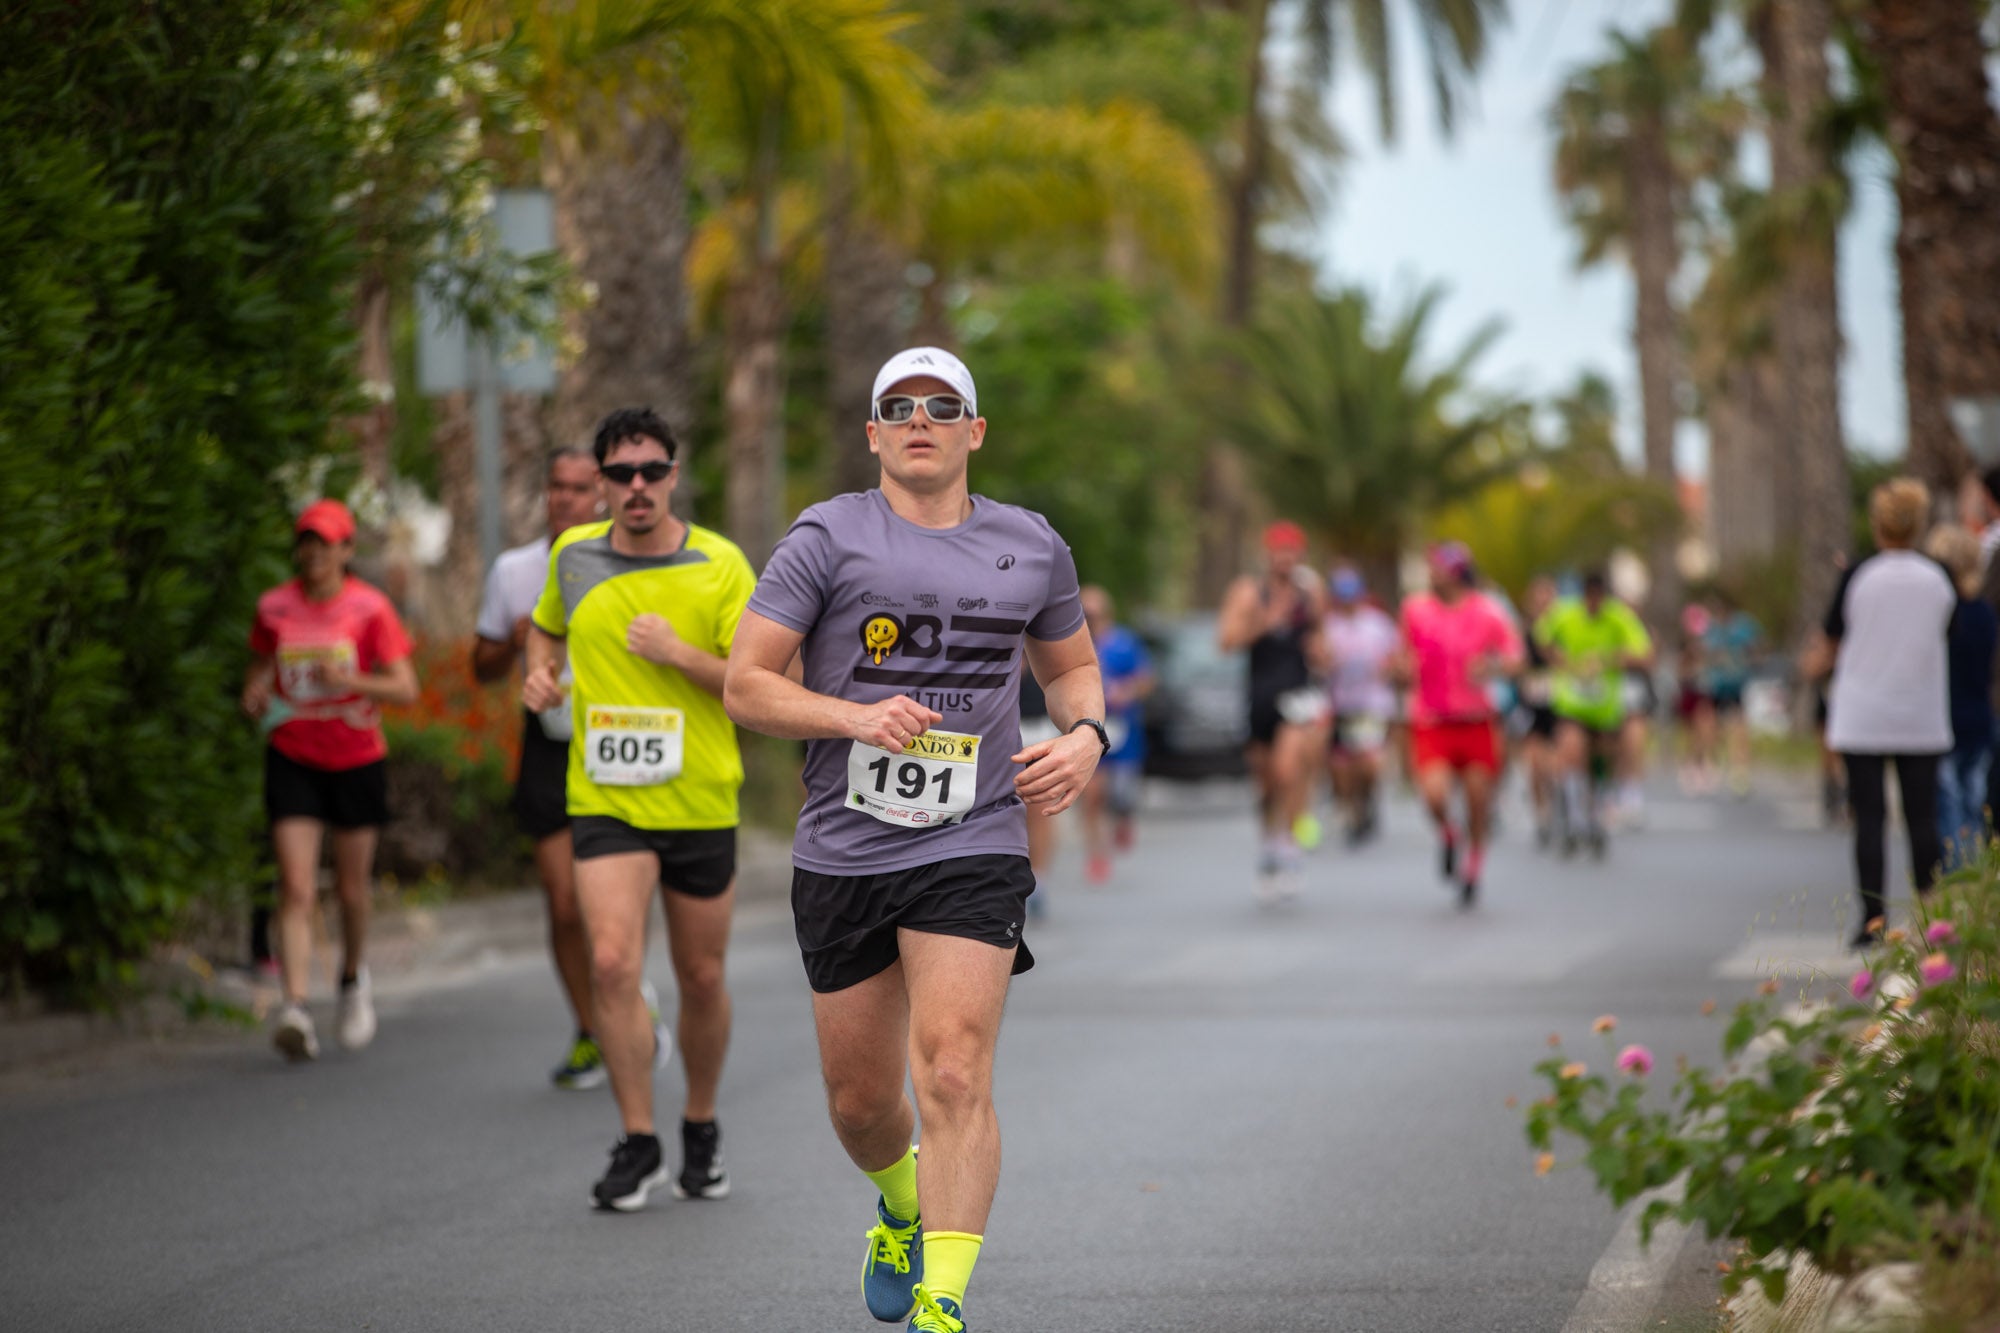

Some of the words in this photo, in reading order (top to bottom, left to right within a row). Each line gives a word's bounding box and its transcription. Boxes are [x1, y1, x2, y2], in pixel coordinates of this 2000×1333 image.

[905, 692, 973, 713] TIUS
[598, 735, 663, 765] 605
[903, 739, 955, 756] ONDO
[868, 756, 952, 804] 191
